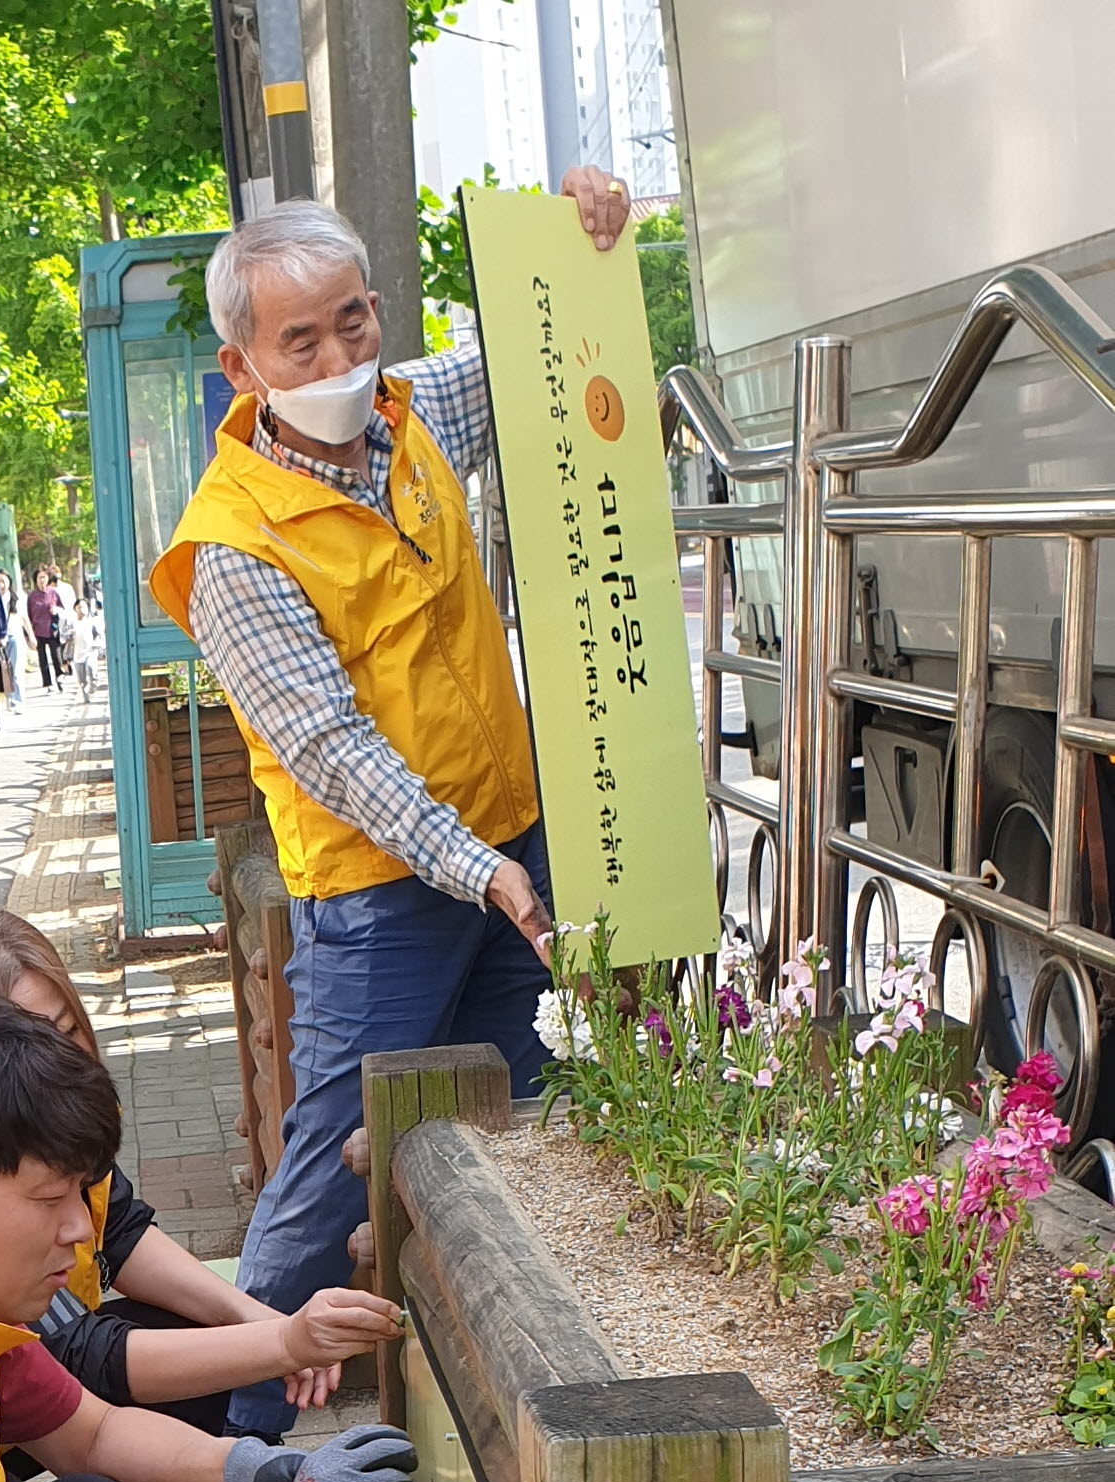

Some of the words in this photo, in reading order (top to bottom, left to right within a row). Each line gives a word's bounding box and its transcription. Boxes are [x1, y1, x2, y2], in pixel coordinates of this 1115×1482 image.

[533, 276, 569, 424] 무엇일까요?
[556, 435, 577, 486] 것은
[562, 498, 590, 577] 필요한
[597, 472, 648, 694] 웃음입니다
[575, 589, 608, 722] 절대적으로
[593, 737, 616, 792] 삶에
[599, 804, 624, 887] 행복한
